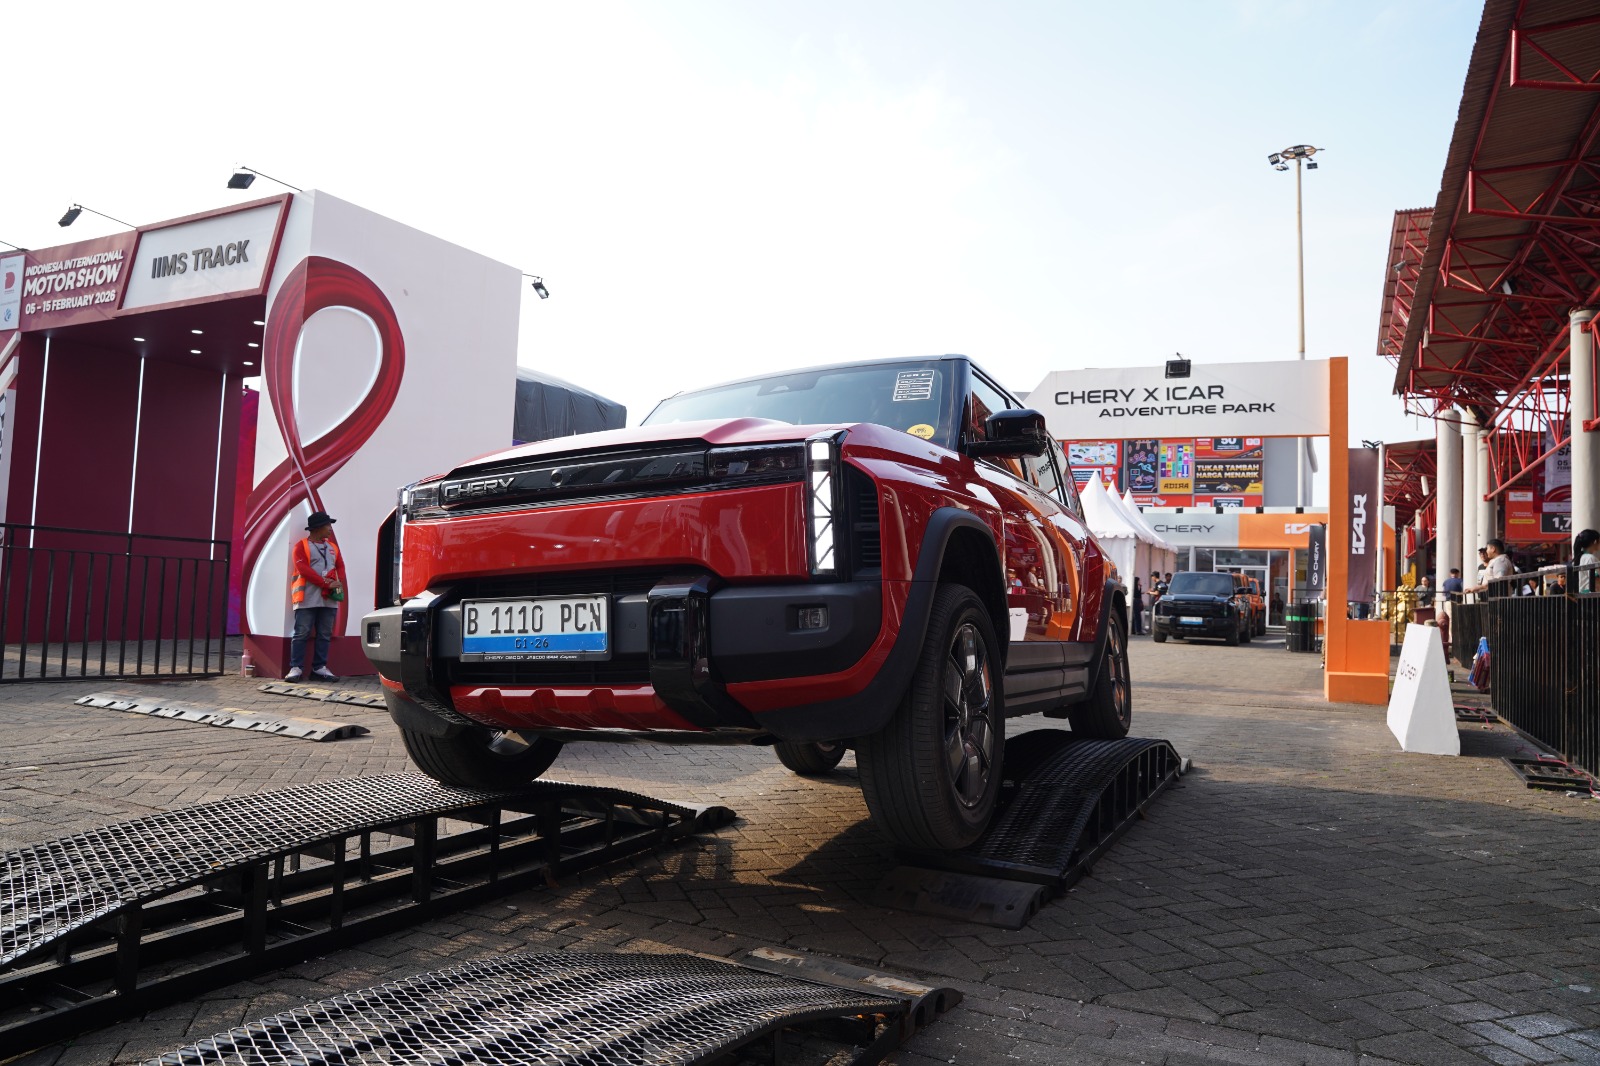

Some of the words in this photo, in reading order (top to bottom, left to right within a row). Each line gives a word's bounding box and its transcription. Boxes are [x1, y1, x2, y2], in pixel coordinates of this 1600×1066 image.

[25, 261, 63, 277] INDONESIA
[64, 249, 124, 271] INTERNATIONAL
[151, 253, 188, 279] IIMS
[192, 239, 250, 272] TRACK
[25, 302, 37, 315] 05
[42, 300, 51, 313] 15
[52, 293, 95, 311] FEBRUARY
[95, 289, 117, 304] 2026
[1054, 388, 1136, 406] CHERY
[1143, 387, 1160, 402] X
[1166, 385, 1225, 401] ICAR
[1099, 405, 1217, 418] ADVENTURE
[1222, 403, 1276, 414] PARK
[444, 477, 515, 497] CHERY
[1153, 524, 1215, 533] CHERY
[467, 607, 479, 635] B
[490, 605, 544, 634] 1110
[560, 602, 602, 632] PCN
